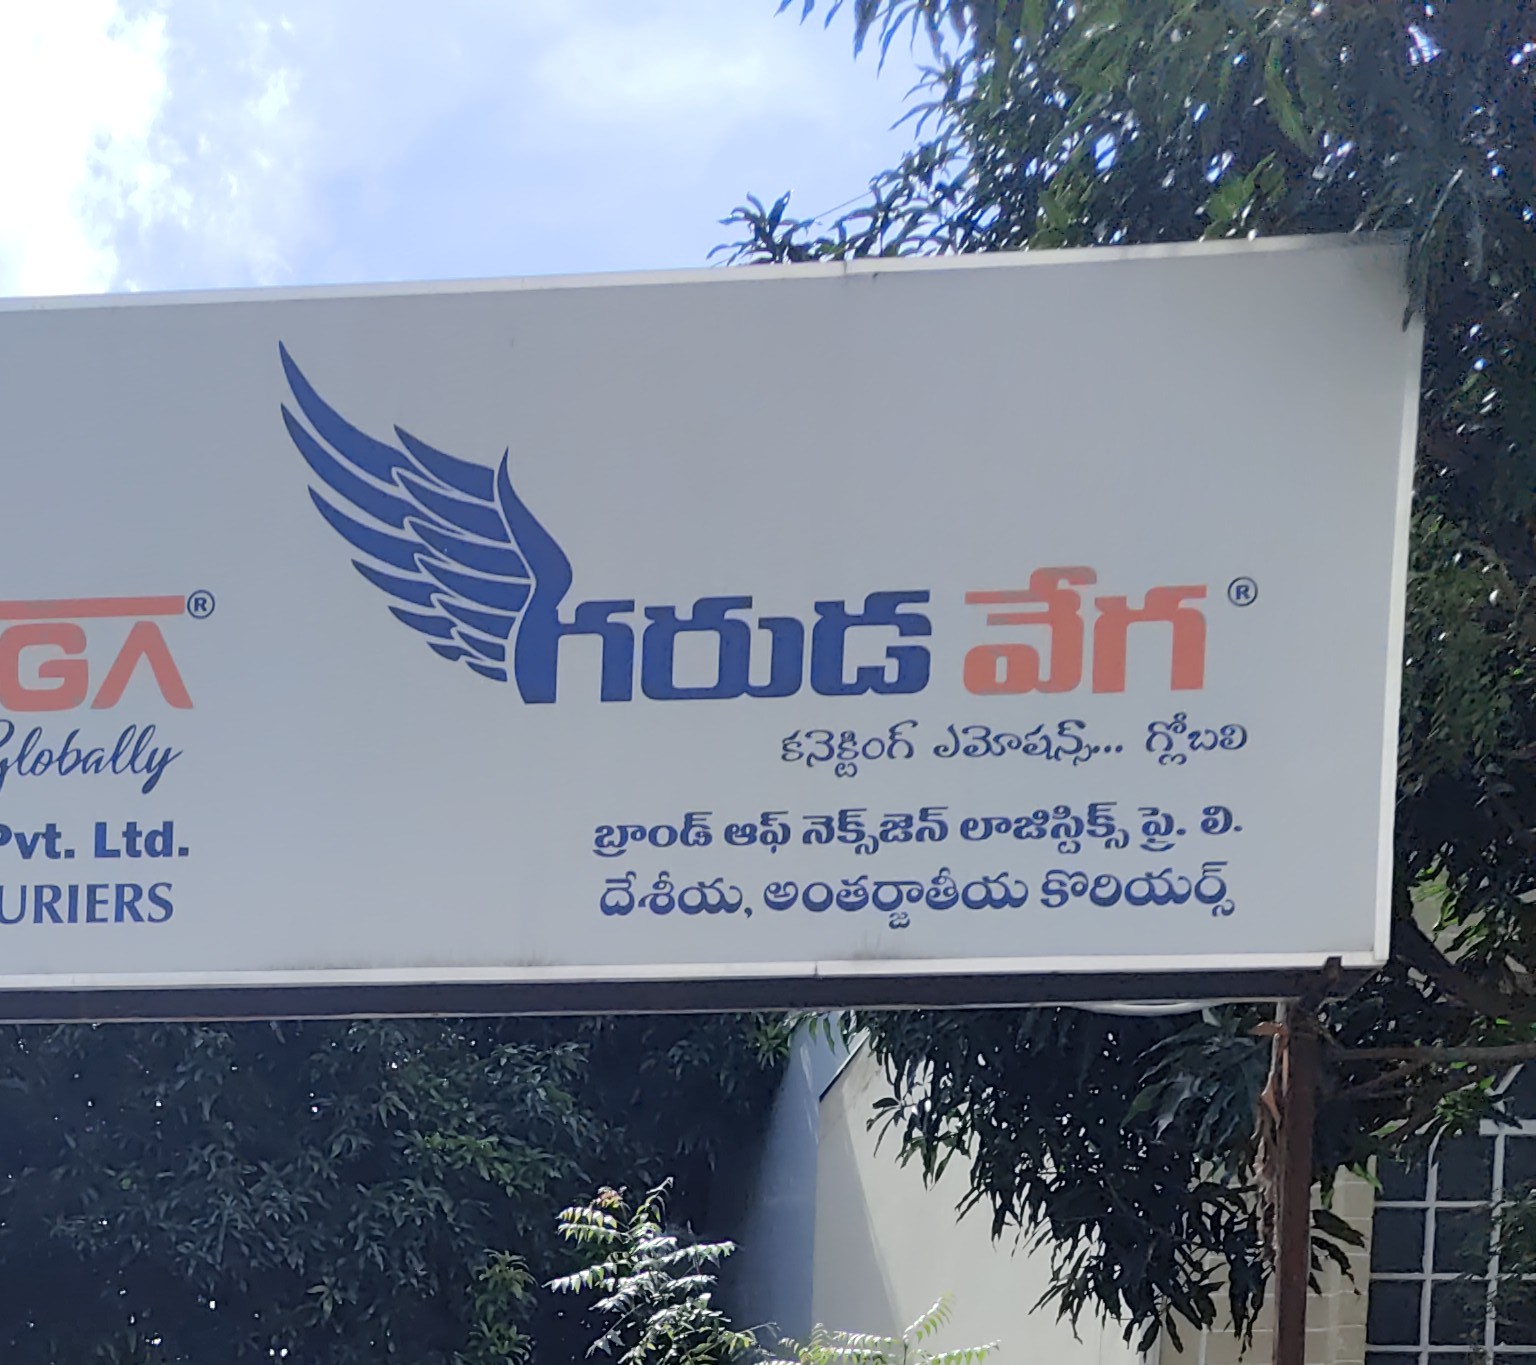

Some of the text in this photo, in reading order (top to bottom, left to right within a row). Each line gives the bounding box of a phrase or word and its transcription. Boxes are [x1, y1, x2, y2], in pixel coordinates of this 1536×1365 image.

[515, 589, 933, 705] గరుడ
[962, 565, 1208, 695] వేగ
[93, 820, 191, 859] Ltd.
[592, 811, 714, 859] బ్రాండ్
[723, 810, 792, 855] ఆఫ్
[958, 801, 1131, 855] లాజిస్టిక్స్
